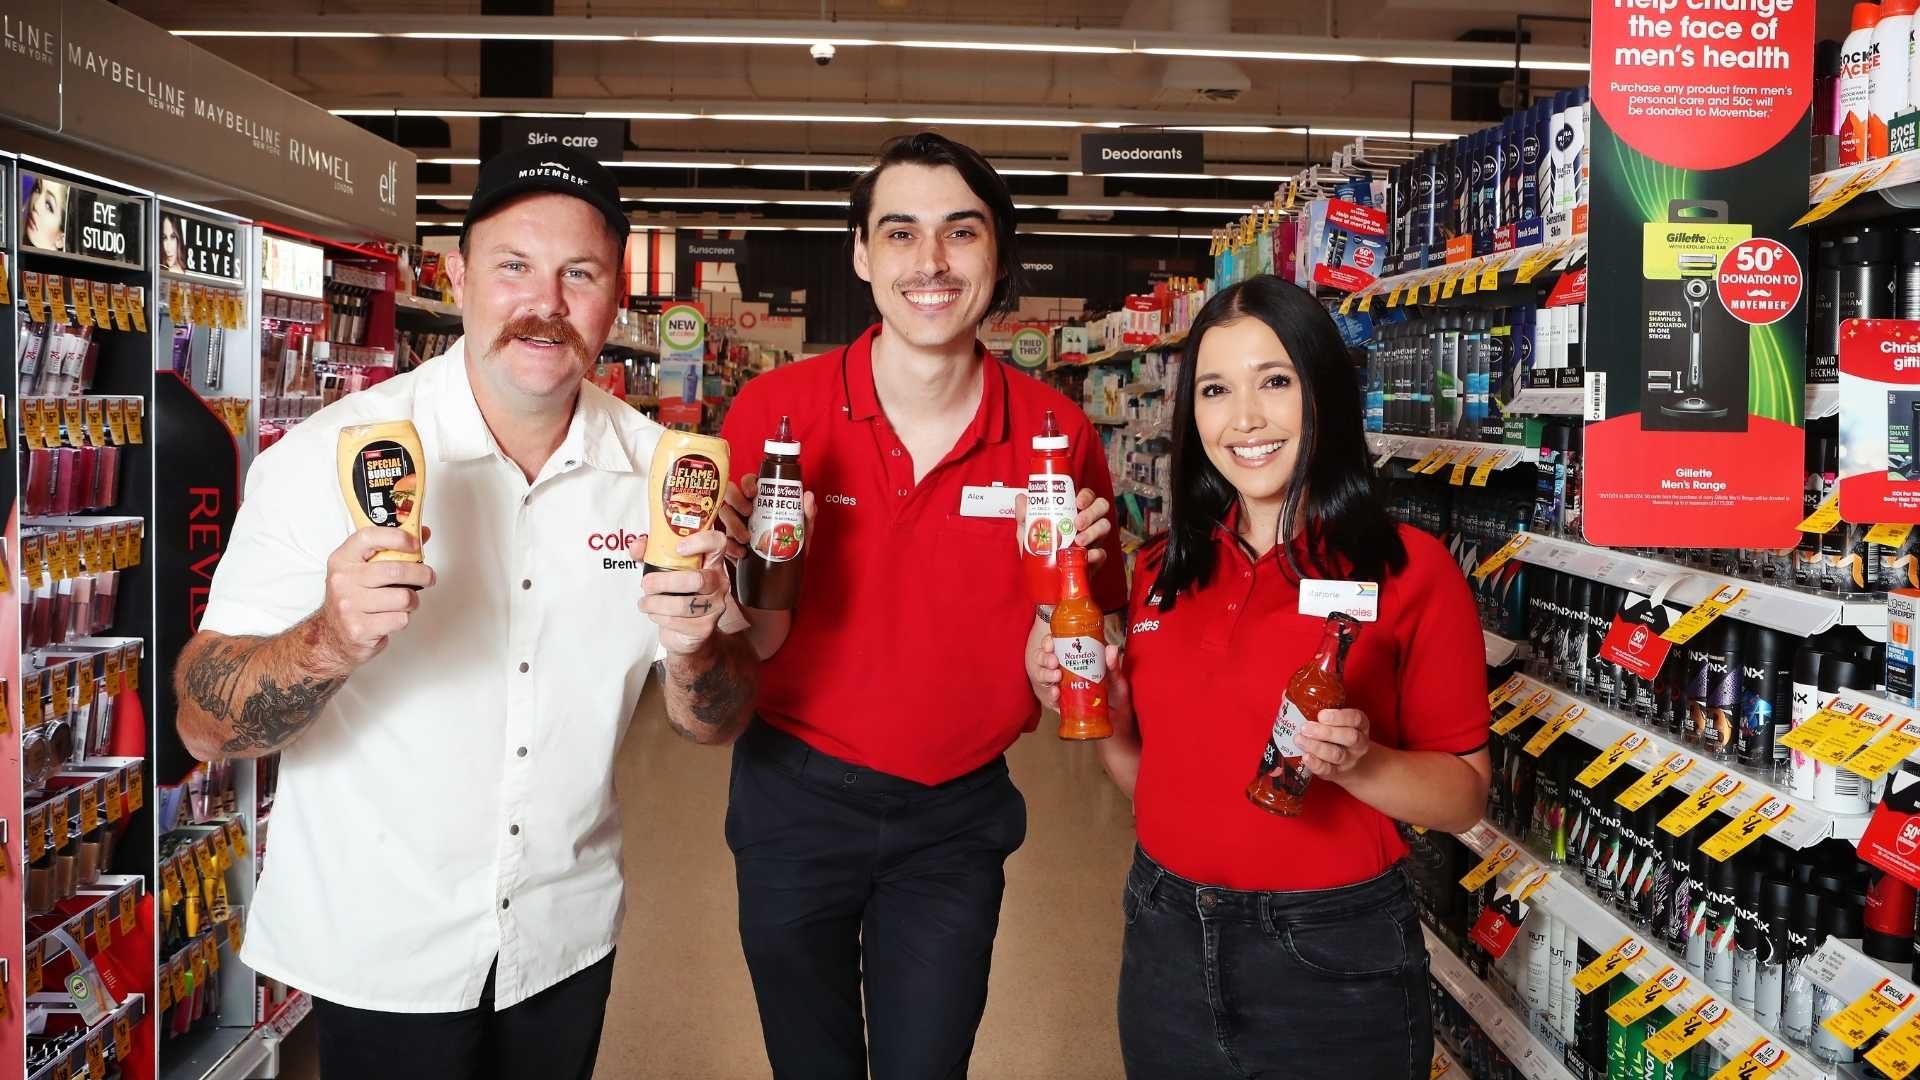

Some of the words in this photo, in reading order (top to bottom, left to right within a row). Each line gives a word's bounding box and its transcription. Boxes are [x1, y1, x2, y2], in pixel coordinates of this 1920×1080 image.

[1629, 14, 1672, 37] the
[1680, 15, 1742, 39] face
[1751, 17, 1778, 40] of
[5, 15, 54, 54] LINE
[5, 38, 25, 54] NEW
[1615, 44, 1695, 67] men's
[1703, 45, 1790, 69] health
[68, 42, 185, 109] MAYBELLINE
[1611, 82, 1660, 93] Purchase
[1664, 84, 1683, 95] any
[1687, 84, 1730, 95] product
[1732, 84, 1757, 94] from
[1761, 86, 1792, 96] men's
[149, 97, 164, 109] NEW
[166, 104, 184, 117] YORK
[1629, 95, 1676, 106] personal
[1679, 97, 1704, 105] care
[1708, 96, 1729, 106] and
[1732, 96, 1752, 106] 50c
[1756, 97, 1773, 106] will
[1628, 105, 1643, 115] be
[1645, 106, 1692, 117] donated
[1695, 107, 1706, 116] to
[195, 97, 281, 148] MAYBELLINE
[1891, 122, 1915, 139] ROCK
[528, 132, 557, 145] Skin
[562, 136, 598, 147] care
[1891, 134, 1915, 153] FACE
[1101, 147, 1183, 160] Deodorants
[290, 138, 353, 184] RIMMEL
[380, 159, 398, 206] elf
[519, 168, 585, 186] MOVEMBER
[93, 201, 117, 226] EYE
[83, 226, 125, 254] STUDIO
[195, 225, 234, 253] LIPS
[689, 244, 735, 256] Sunscreen
[1737, 247, 1784, 272] 50¢
[1022, 262, 1054, 272] ampoo
[1721, 274, 1782, 285] DONATION
[1784, 275, 1798, 285] TO
[1730, 300, 1788, 310] MOVEMBER
[668, 319, 696, 330] NEW
[1815, 356, 1836, 367] DAVID
[366, 458, 402, 471] SPECIAL
[367, 467, 402, 480] BURGER
[678, 467, 714, 479] FLAME
[1675, 467, 1713, 479] Gillette
[368, 478, 394, 488] SAUCE
[667, 476, 718, 491] GRILLED
[1661, 480, 1690, 490] Men's
[1692, 480, 1726, 492] Range
[825, 494, 857, 506] coles
[968, 493, 984, 501] Alex
[588, 529, 649, 551] cole
[603, 558, 637, 569] Brent
[1345, 608, 1373, 617] coles
[1132, 618, 1160, 634] coles
[1064, 651, 1096, 660] Nando's
[1835, 701, 1854, 712] SPECIAL
[1863, 711, 1883, 722] SPECIAL
[1904, 724, 1920, 735] SPECIA
[1884, 985, 1905, 1002] SPECIAL
[1755, 1052, 1770, 1065] PRICE
[1763, 1047, 1775, 1057] 1/2
